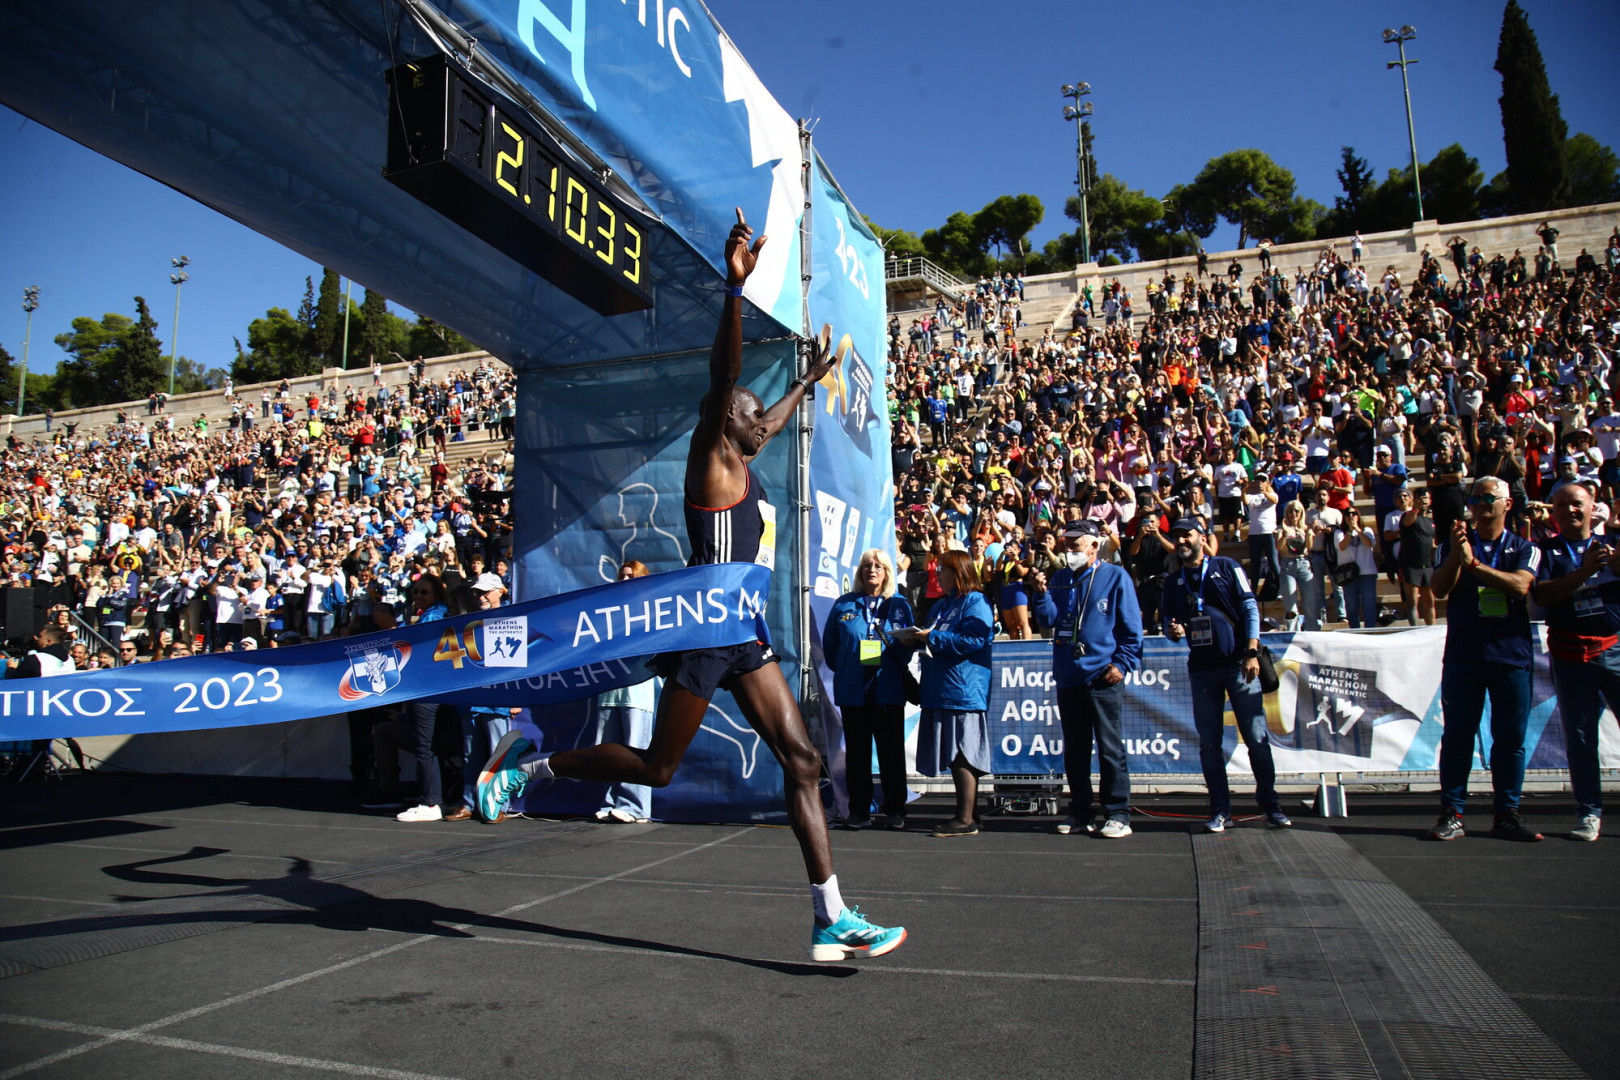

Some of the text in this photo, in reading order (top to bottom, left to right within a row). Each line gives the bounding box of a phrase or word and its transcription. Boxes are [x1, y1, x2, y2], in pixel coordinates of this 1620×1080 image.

[572, 587, 728, 648] ATHENS
[1318, 667, 1360, 680] ATHENS
[173, 666, 283, 714] 2023
[1307, 682, 1368, 698] THE AUTHENTIC
[1308, 674, 1368, 691] MARATHON
